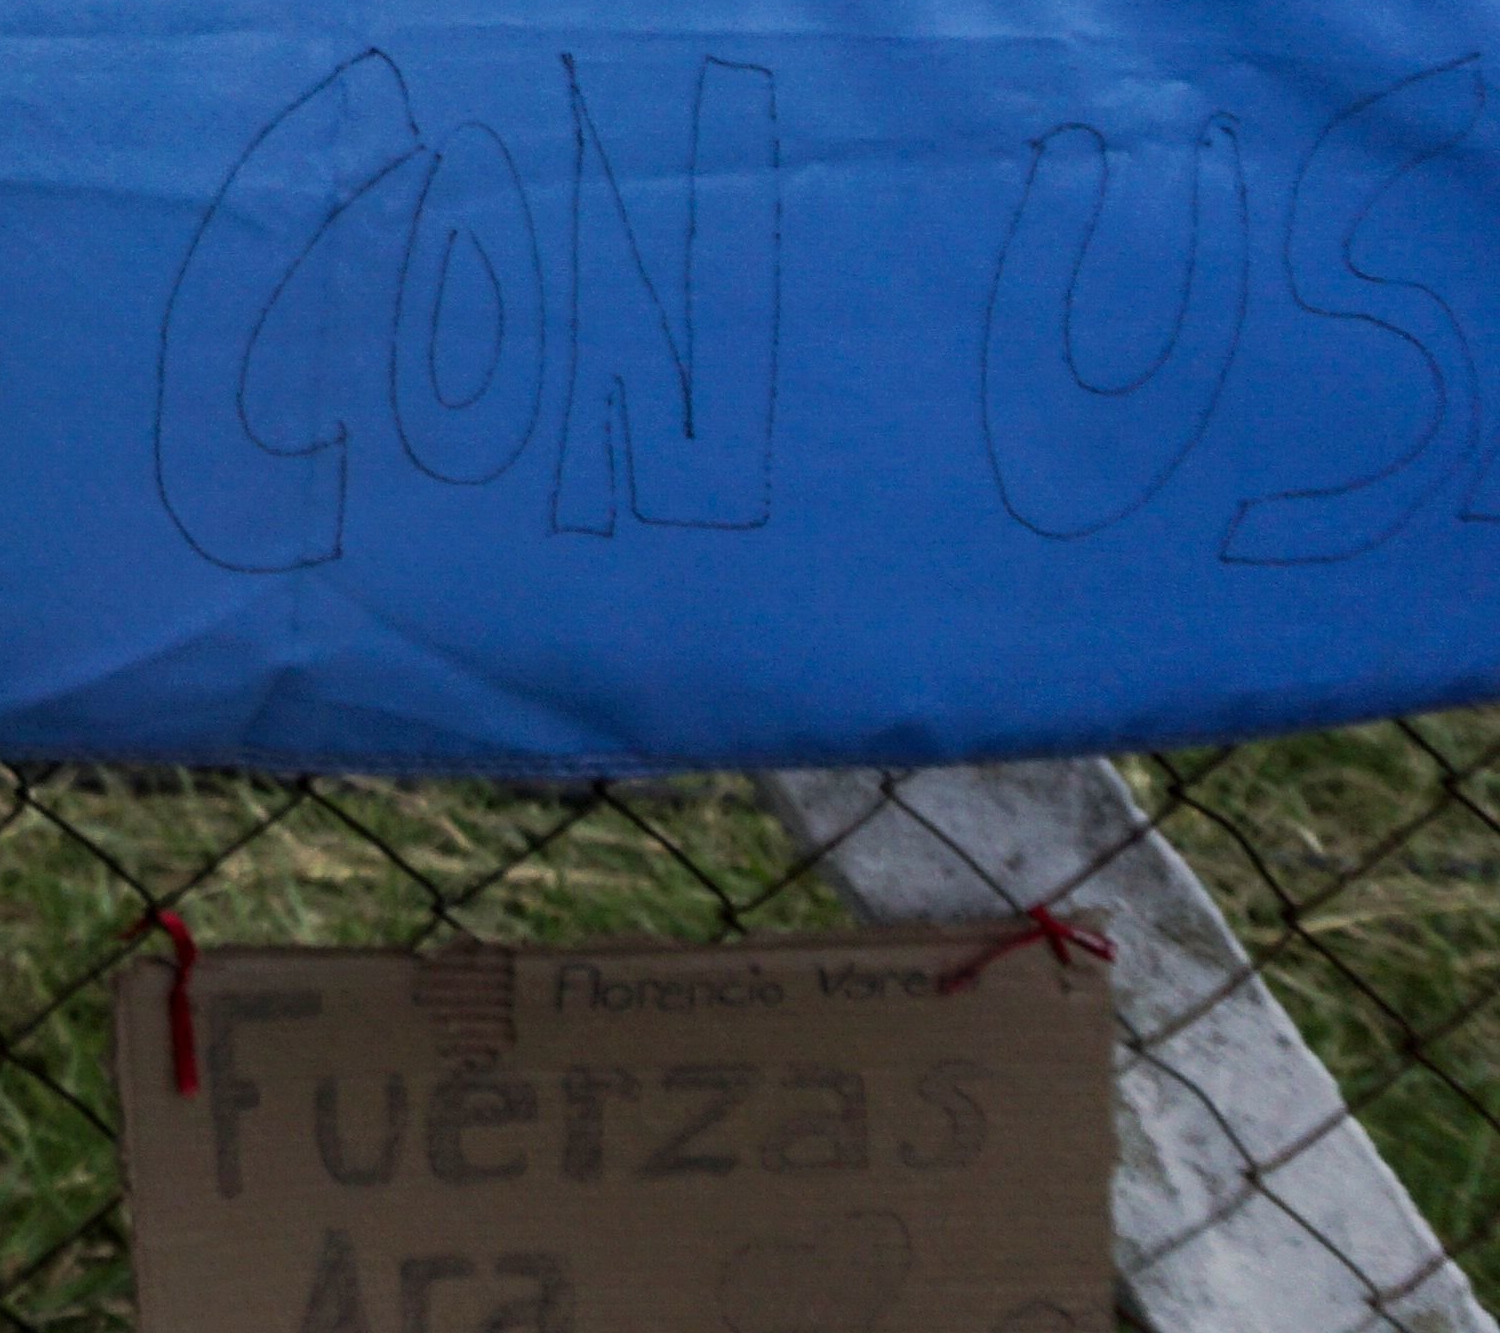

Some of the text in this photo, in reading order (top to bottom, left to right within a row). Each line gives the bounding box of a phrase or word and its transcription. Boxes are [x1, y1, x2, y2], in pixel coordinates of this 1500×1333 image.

[155, 47, 780, 572] CON
[980, 50, 1500, 566] US
[206, 988, 992, 1202] Fuerzas
